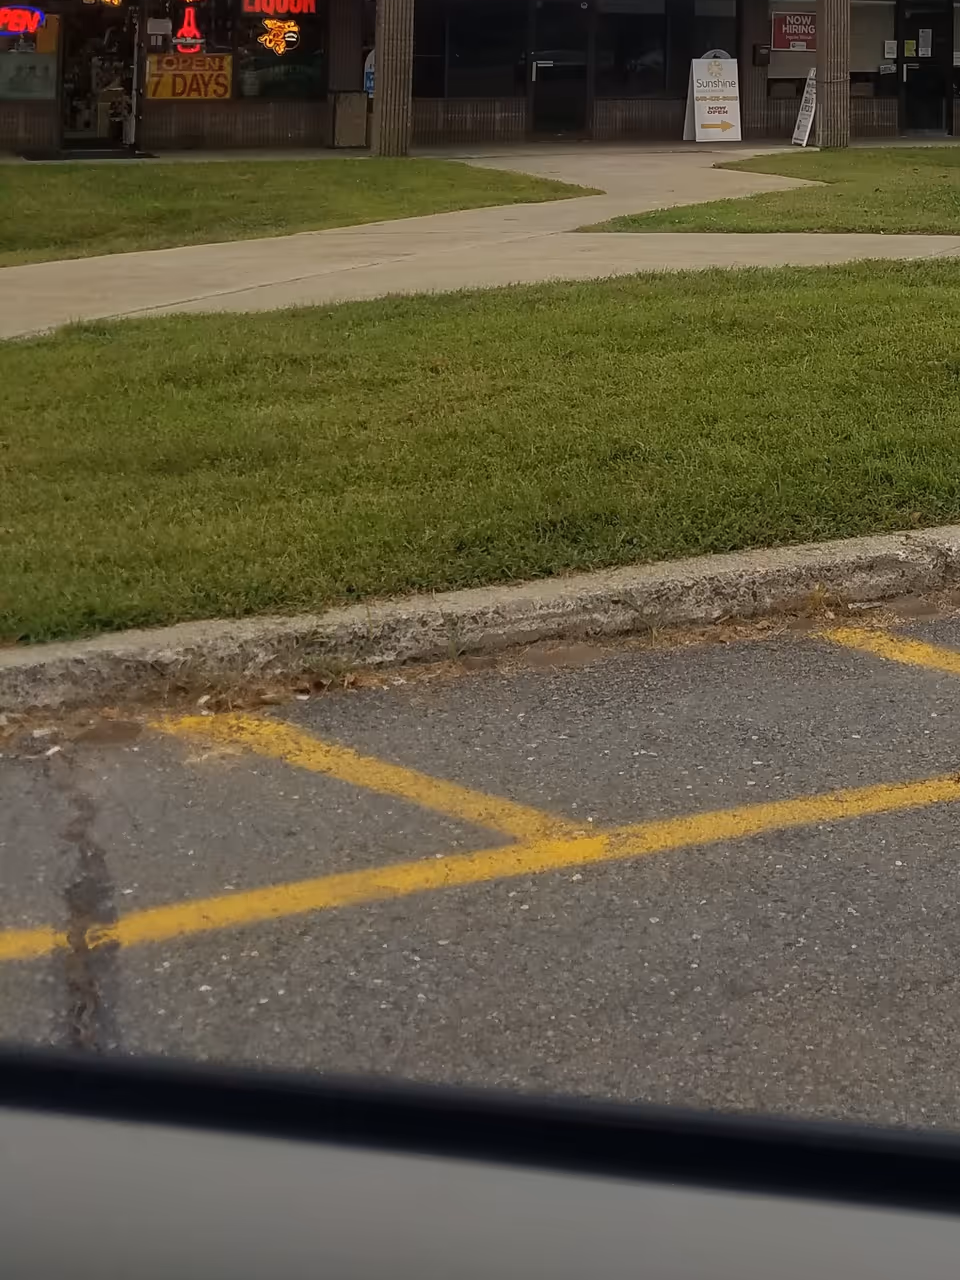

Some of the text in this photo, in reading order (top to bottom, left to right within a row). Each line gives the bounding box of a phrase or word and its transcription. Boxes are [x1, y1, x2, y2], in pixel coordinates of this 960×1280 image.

[786, 15, 812, 25] NOW
[782, 24, 816, 34] HIRING
[162, 56, 220, 70] OPEN
[151, 73, 229, 98] 7 DAYS
[696, 78, 736, 89] Sunshine
